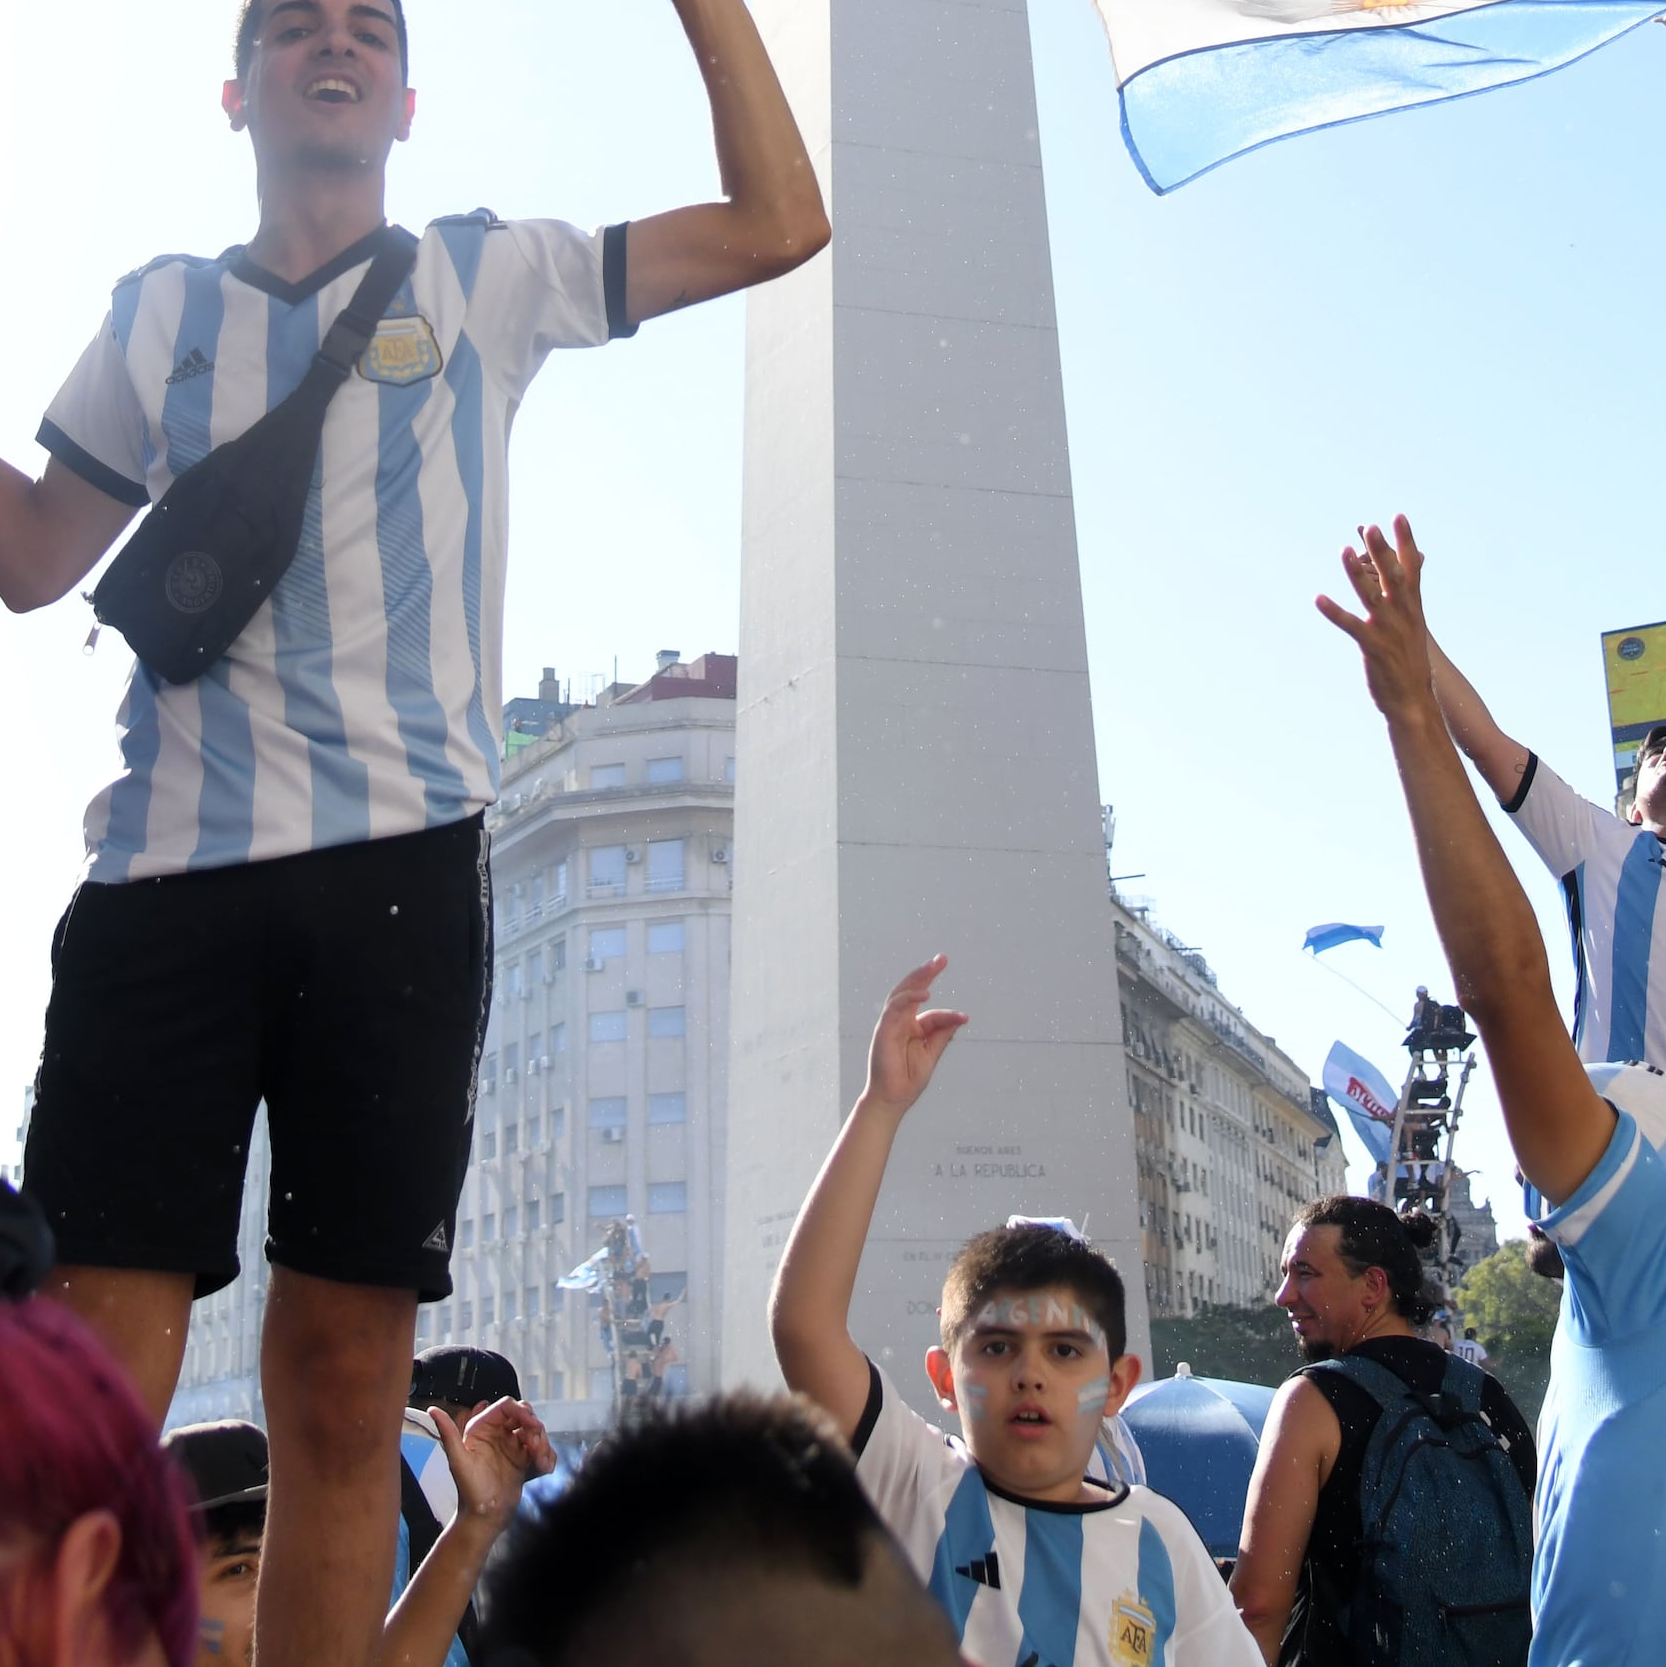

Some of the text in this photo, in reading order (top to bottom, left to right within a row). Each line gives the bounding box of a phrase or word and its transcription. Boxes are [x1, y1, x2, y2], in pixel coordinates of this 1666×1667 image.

[956, 1145, 993, 1156] BUENOS
[935, 1163, 1046, 1179] A LA REPUBLICA
[1120, 1619, 1147, 1654] AFA
